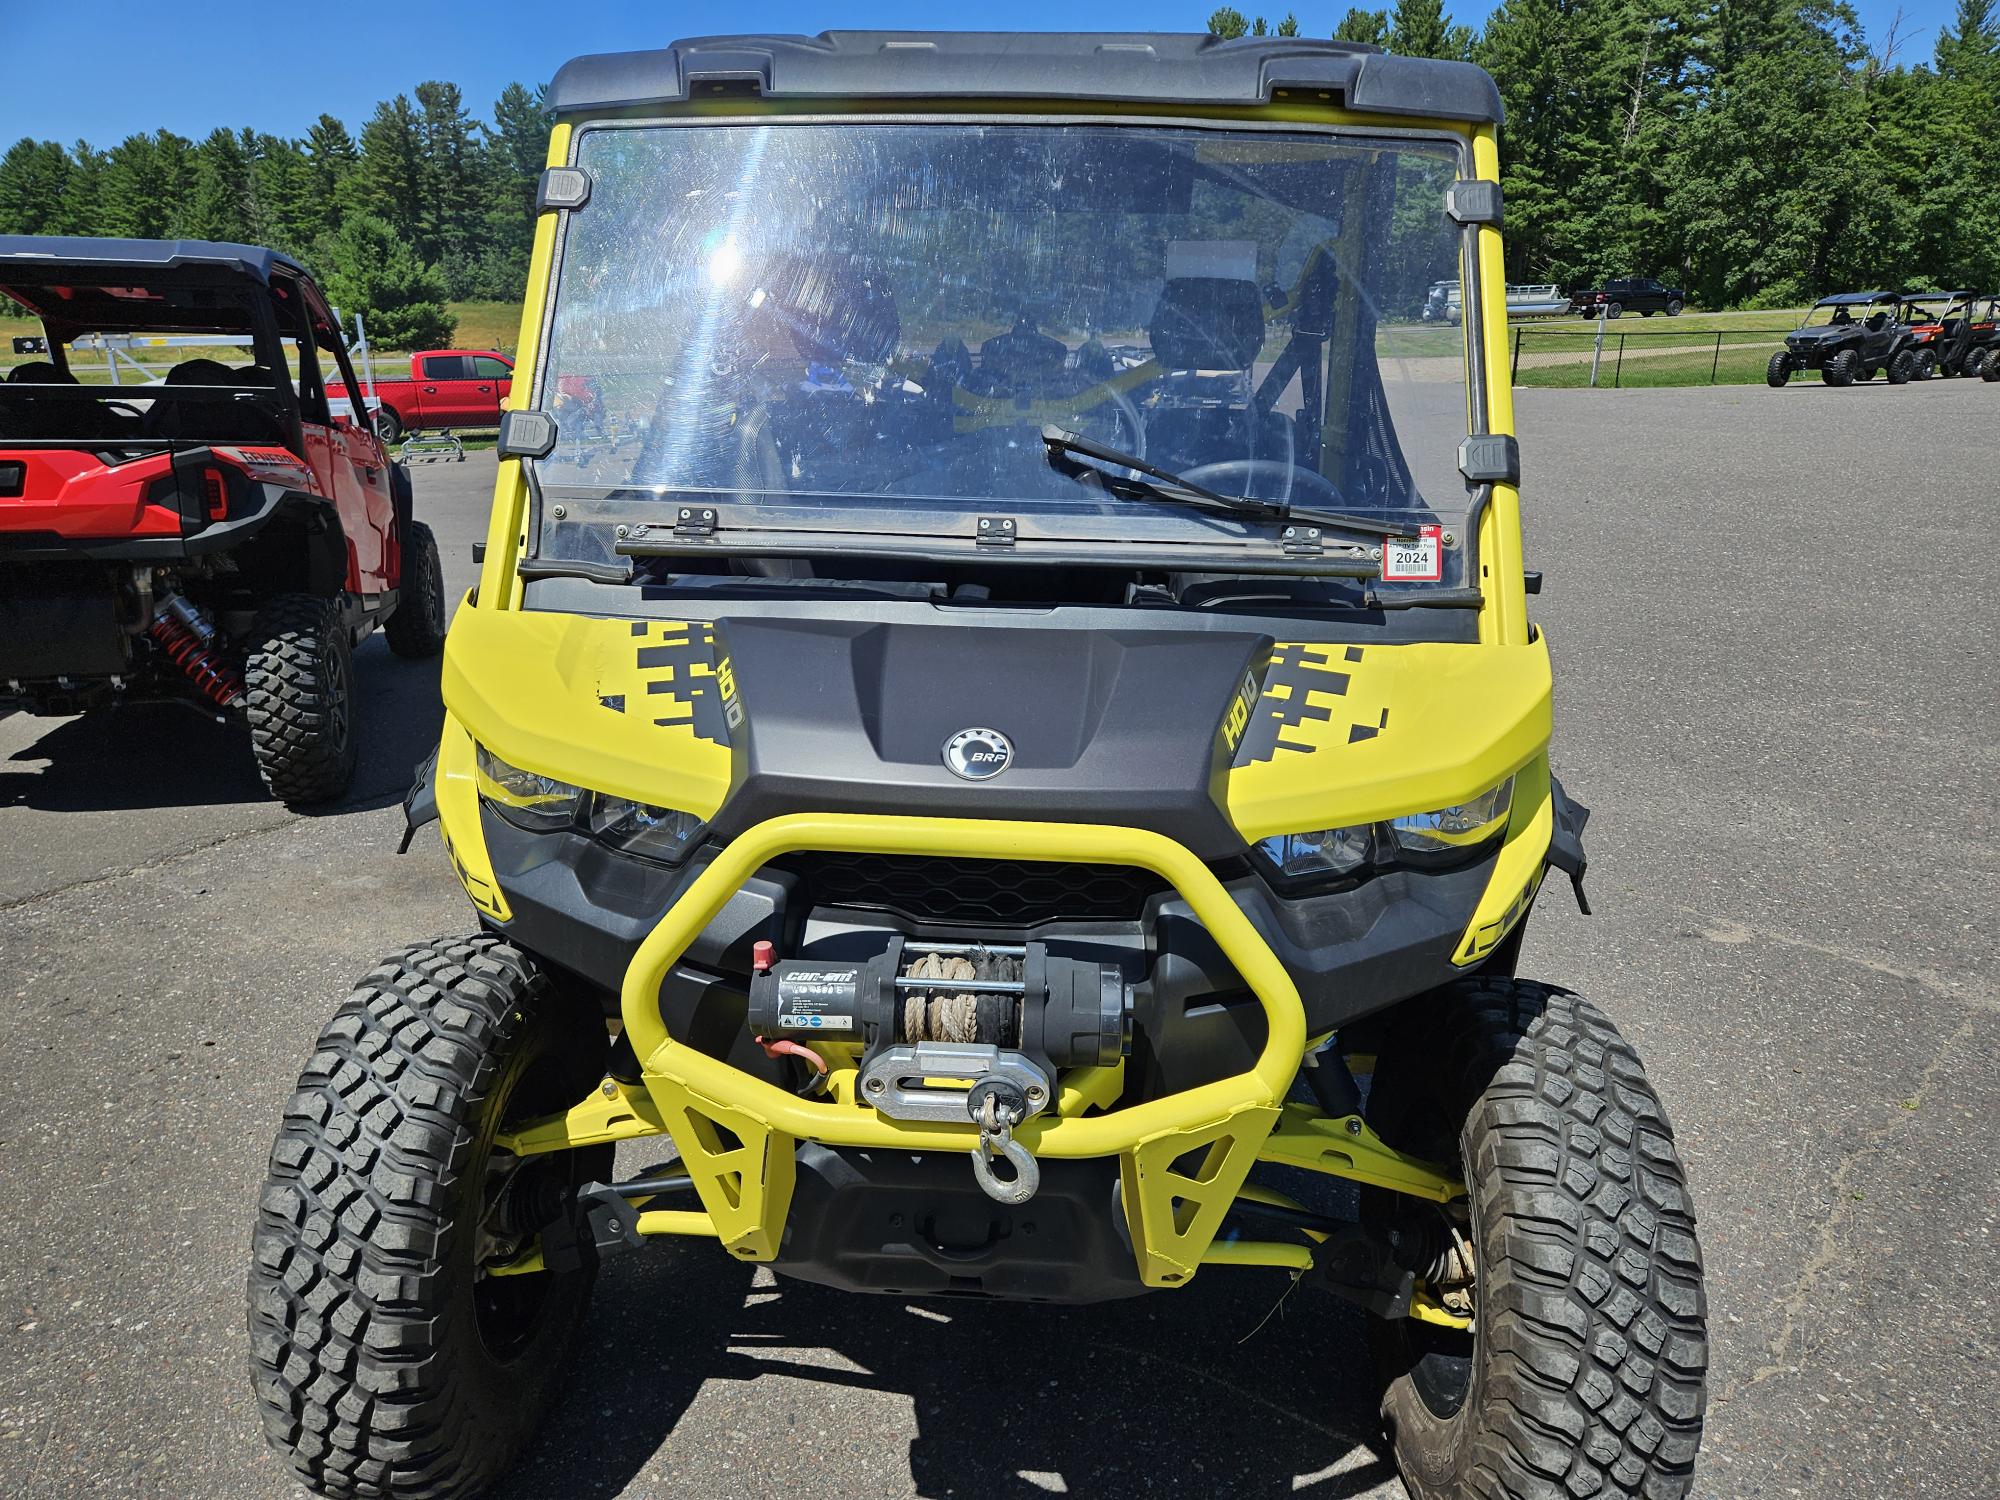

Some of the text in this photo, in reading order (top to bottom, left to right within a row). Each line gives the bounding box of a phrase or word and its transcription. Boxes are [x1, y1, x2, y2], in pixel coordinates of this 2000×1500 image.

[1396, 552, 1428, 564] 2024
[716, 656, 743, 729] HD10
[1223, 670, 1257, 751] HD10
[971, 752, 1006, 763] BRP
